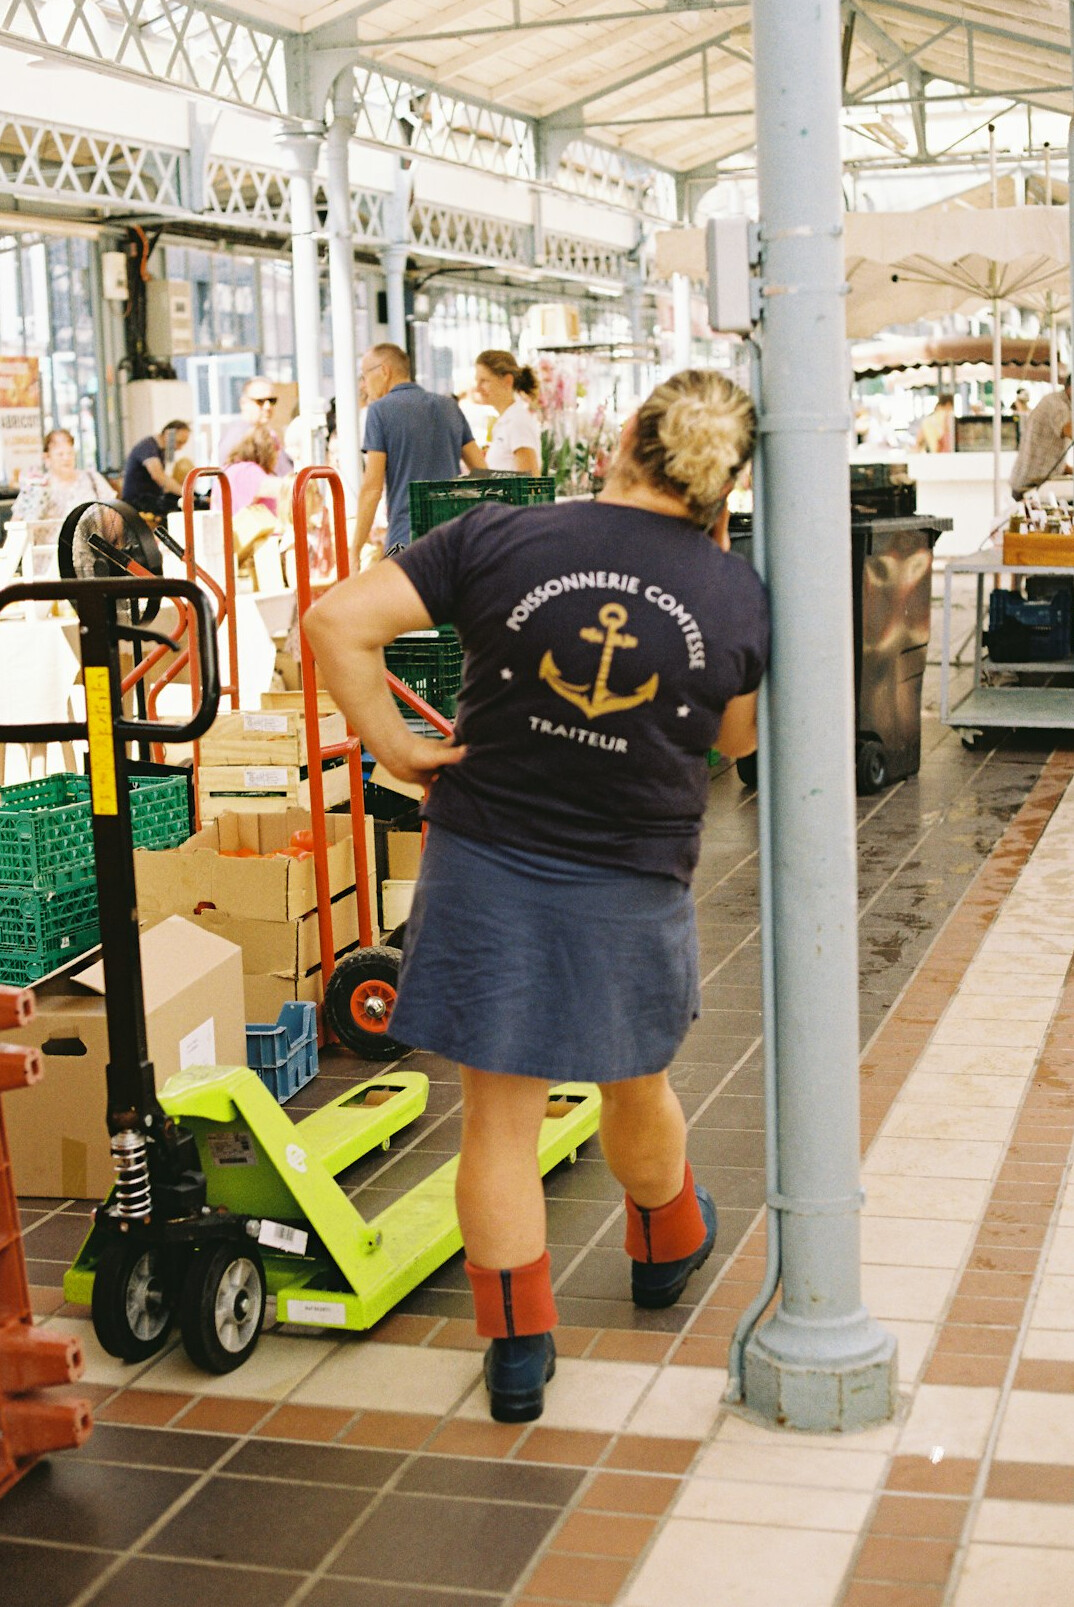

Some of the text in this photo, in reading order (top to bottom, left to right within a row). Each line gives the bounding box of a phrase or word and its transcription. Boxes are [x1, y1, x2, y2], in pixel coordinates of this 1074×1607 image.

[506, 571, 706, 670] POISSONNERIE COMTESSE
[528, 715, 629, 754] TRAITEUR
